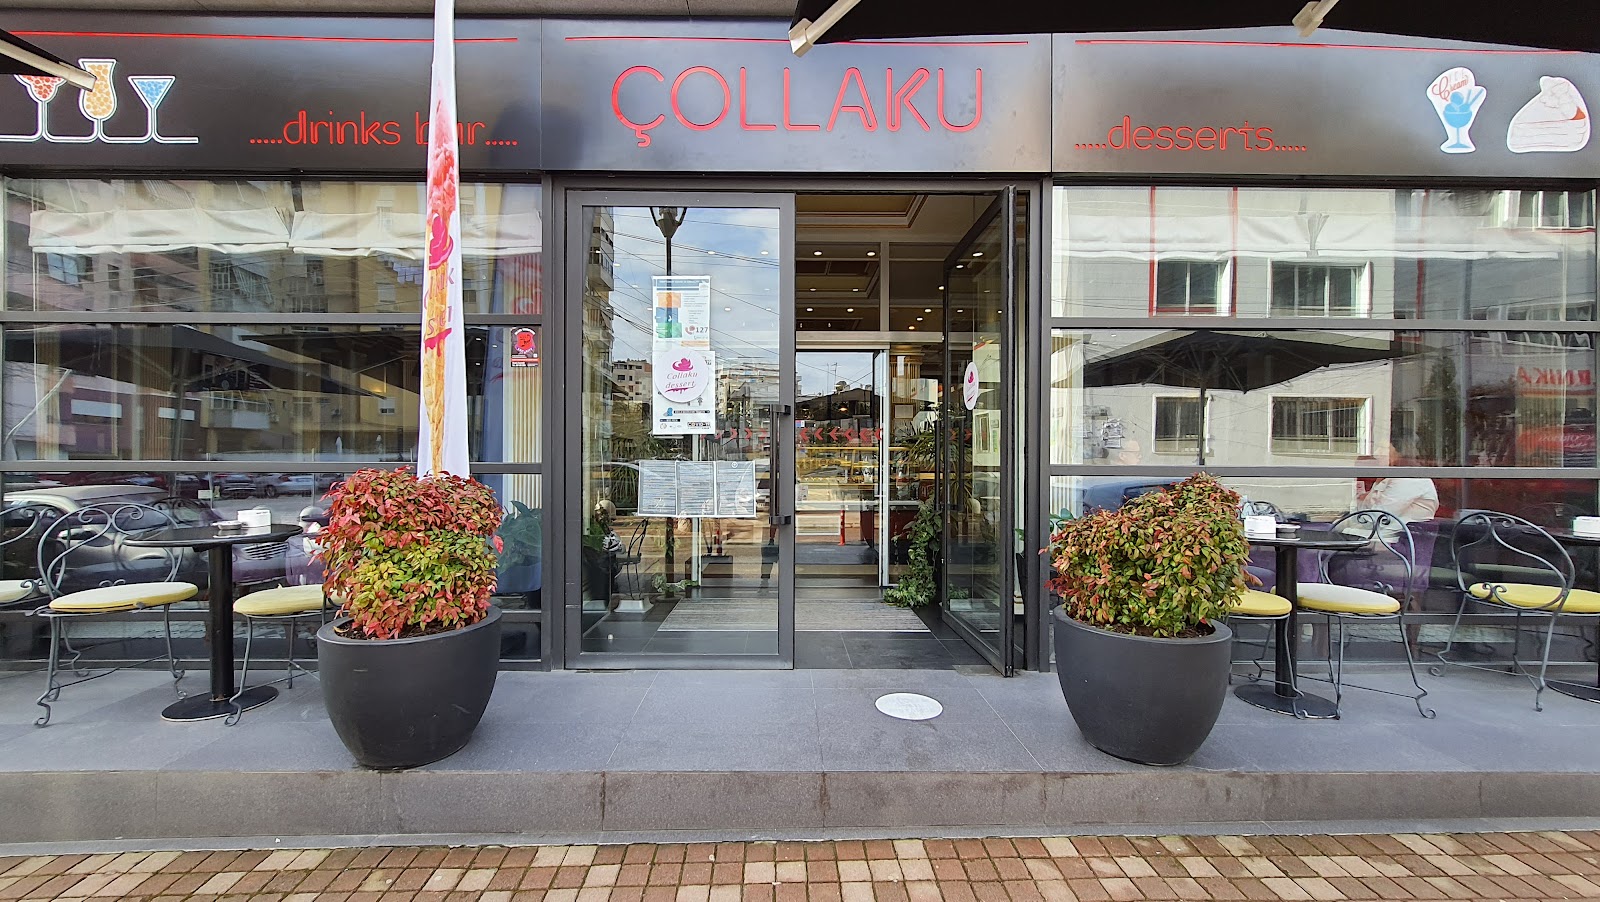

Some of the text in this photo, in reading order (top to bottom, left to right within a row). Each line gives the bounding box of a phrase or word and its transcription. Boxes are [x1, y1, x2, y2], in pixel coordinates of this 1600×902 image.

[1432, 75, 1469, 102] Cream
[611, 65, 983, 148] ÇOLLAKU
[666, 371, 698, 380] Collaku
[665, 381, 697, 389] dessert
